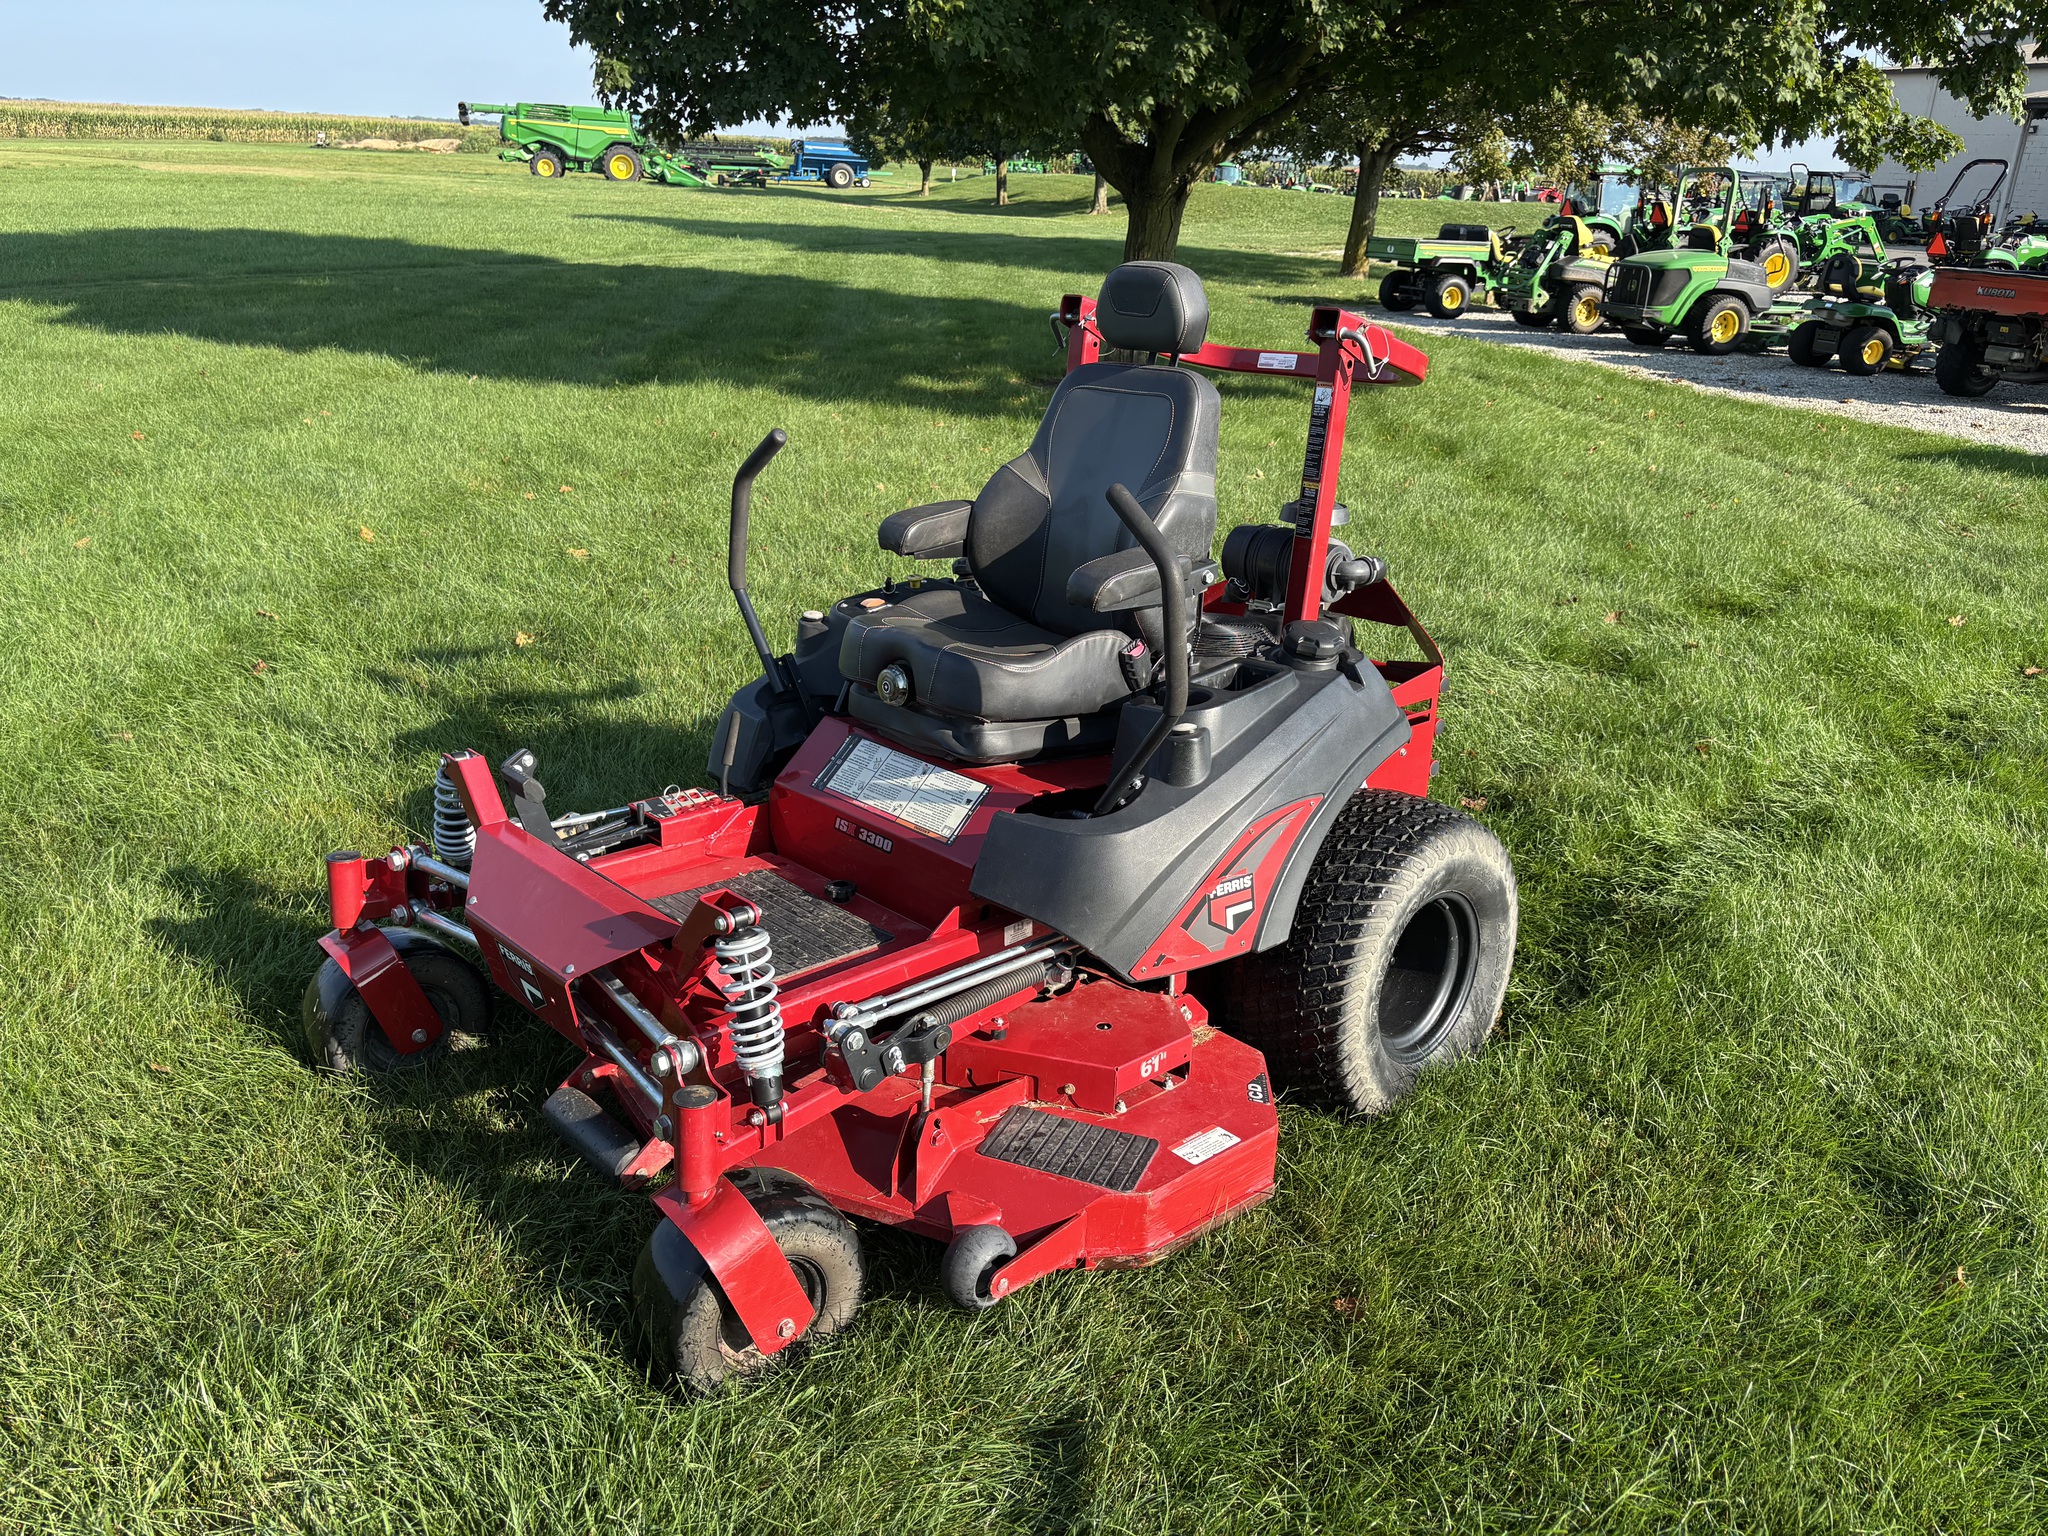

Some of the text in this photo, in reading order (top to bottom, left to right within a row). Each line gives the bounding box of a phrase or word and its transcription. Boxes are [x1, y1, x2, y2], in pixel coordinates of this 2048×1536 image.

[1976, 286, 2016, 299] KUBOTA
[835, 817, 893, 852] ISX 3300
[497, 942, 534, 976] FERRIS
[1140, 1051, 1167, 1078] 61"
